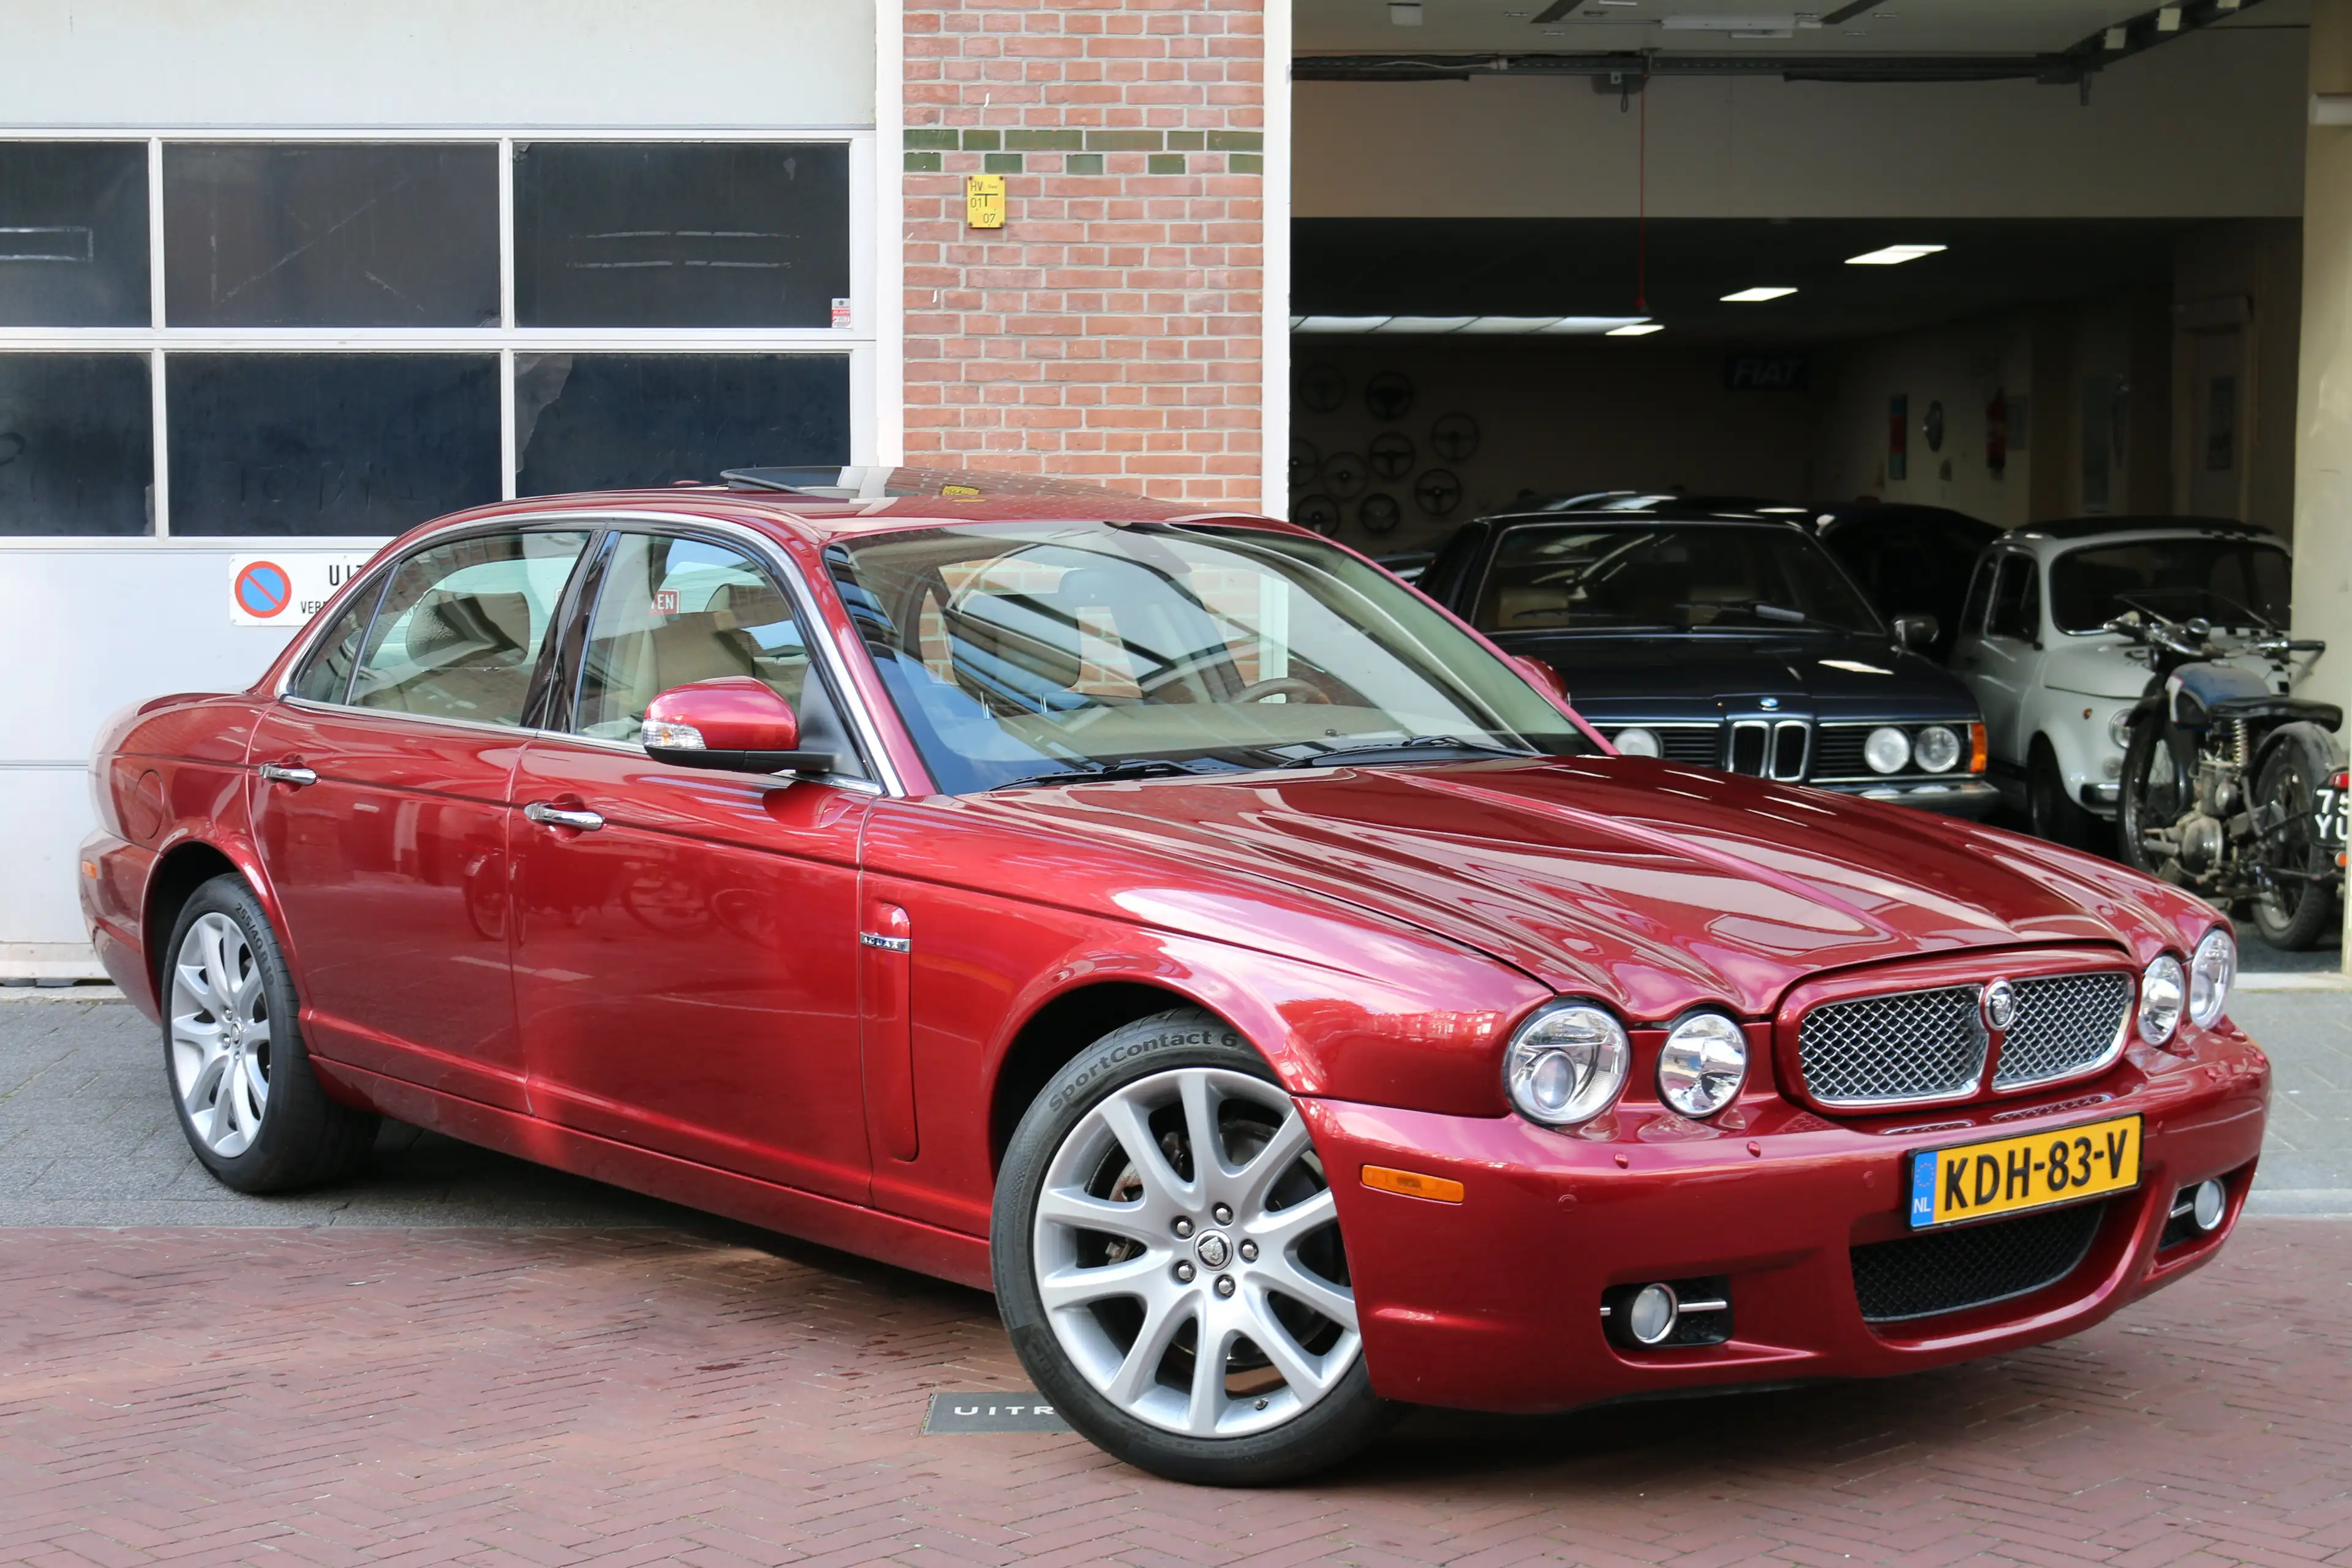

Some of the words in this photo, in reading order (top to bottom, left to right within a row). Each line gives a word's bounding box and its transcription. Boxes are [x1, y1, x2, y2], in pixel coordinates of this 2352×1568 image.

[970, 181, 983, 192] HV
[1732, 358, 1804, 386] FIAT
[860, 935, 899, 949] AGUAR
[1048, 1030, 1212, 1113] SportContact
[1220, 1033, 1238, 1047] 6
[1945, 1128, 2128, 1212] KDH-83-V
[1913, 1196, 1931, 1214] NL
[954, 1406, 1055, 1416] UITR
